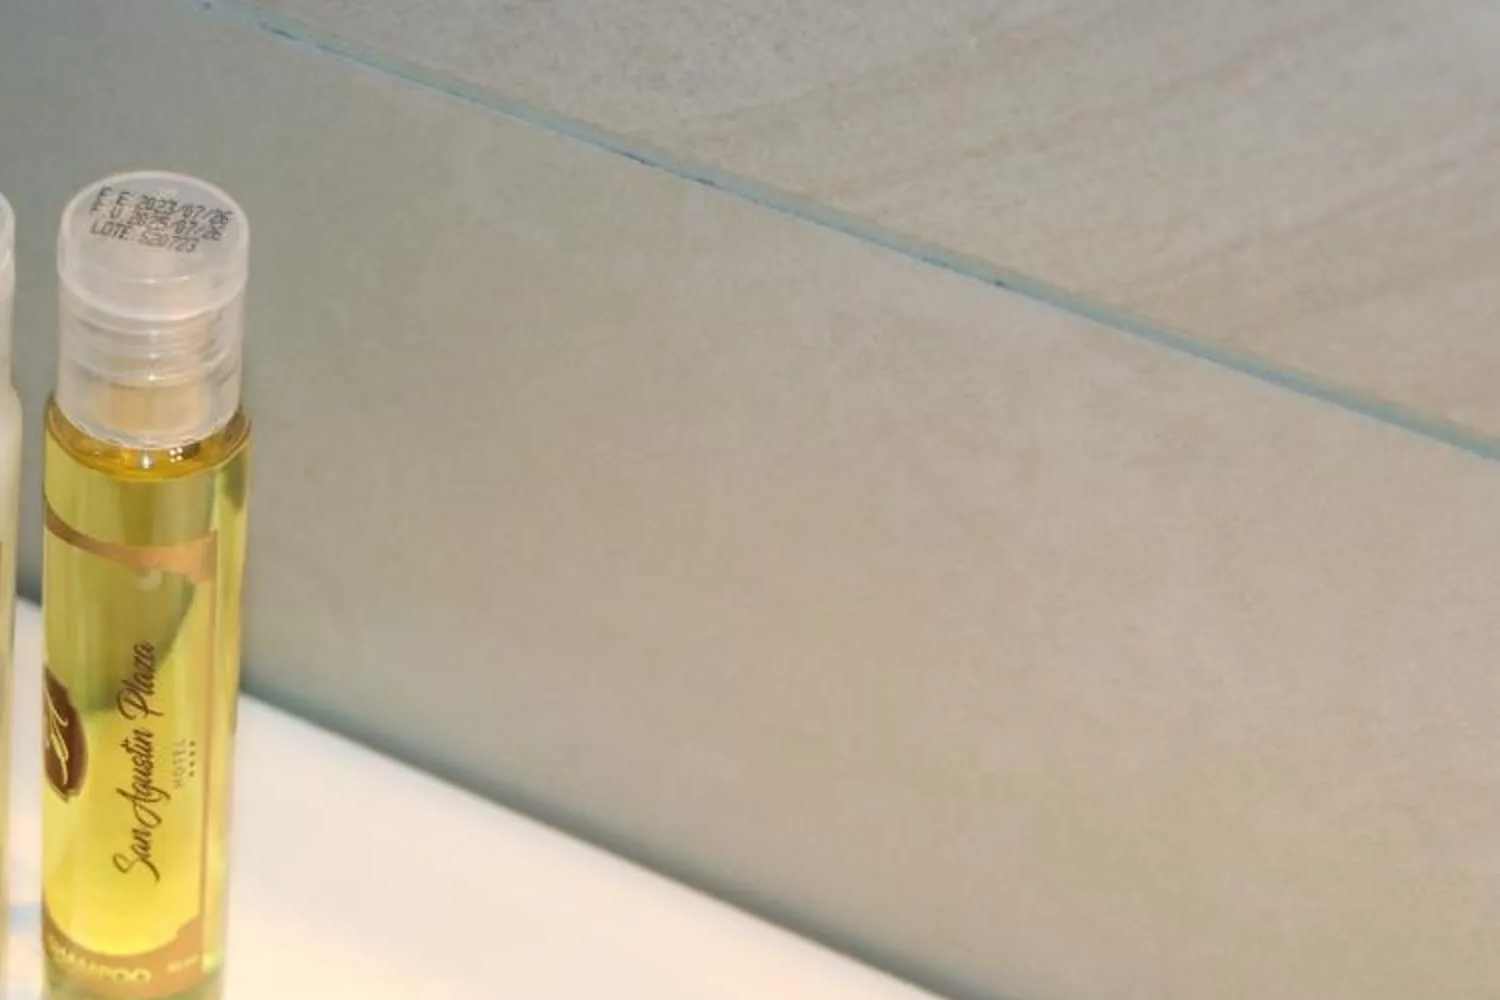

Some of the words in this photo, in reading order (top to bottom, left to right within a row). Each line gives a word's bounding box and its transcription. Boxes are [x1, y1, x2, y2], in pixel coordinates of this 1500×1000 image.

[116, 639, 165, 722] Plaza
[170, 738, 188, 790] HOTEL
[112, 827, 162, 884] San
